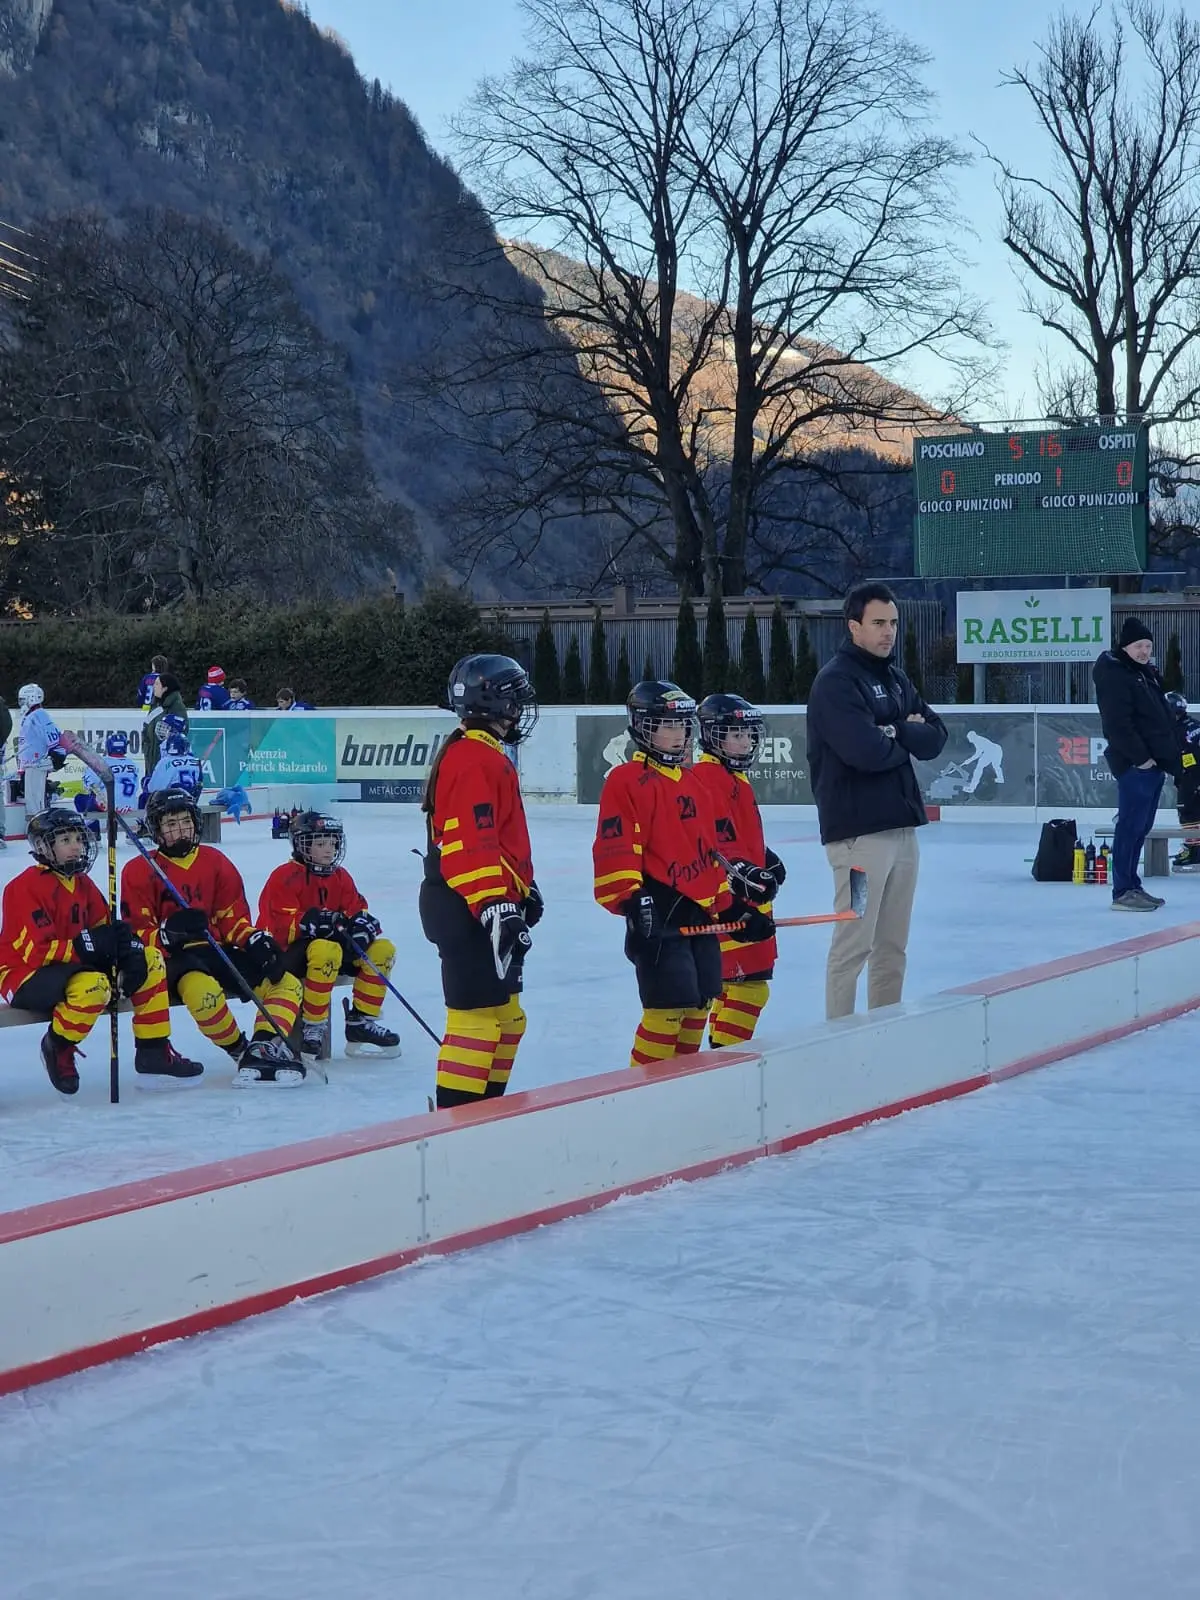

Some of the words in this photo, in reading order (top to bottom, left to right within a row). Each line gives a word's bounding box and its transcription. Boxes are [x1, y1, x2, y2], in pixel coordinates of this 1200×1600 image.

[1099, 434, 1136, 450] OSPITI
[921, 442, 985, 459] POSCHIAVO
[994, 472, 1041, 486] PERIODO
[920, 499, 952, 513] GIOCO
[956, 497, 1013, 512] PUNIZIONI
[1042, 495, 1076, 508] GIOCO
[1079, 492, 1139, 507] PUNIZIONI
[963, 616, 1103, 644] RASELLI
[982, 650, 1042, 658] ERBORISTERIA
[1044, 649, 1092, 657] BIOLOGICA
[248, 749, 287, 762] Agenzia
[341, 734, 450, 766] bondol
[1057, 736, 1109, 764] REP
[239, 761, 275, 772] Patrick
[278, 762, 328, 773] Balzarolo
[764, 768, 772, 779] ti
[774, 770, 806, 779] serve.
[368, 785, 426, 796] METALCOSTRU
